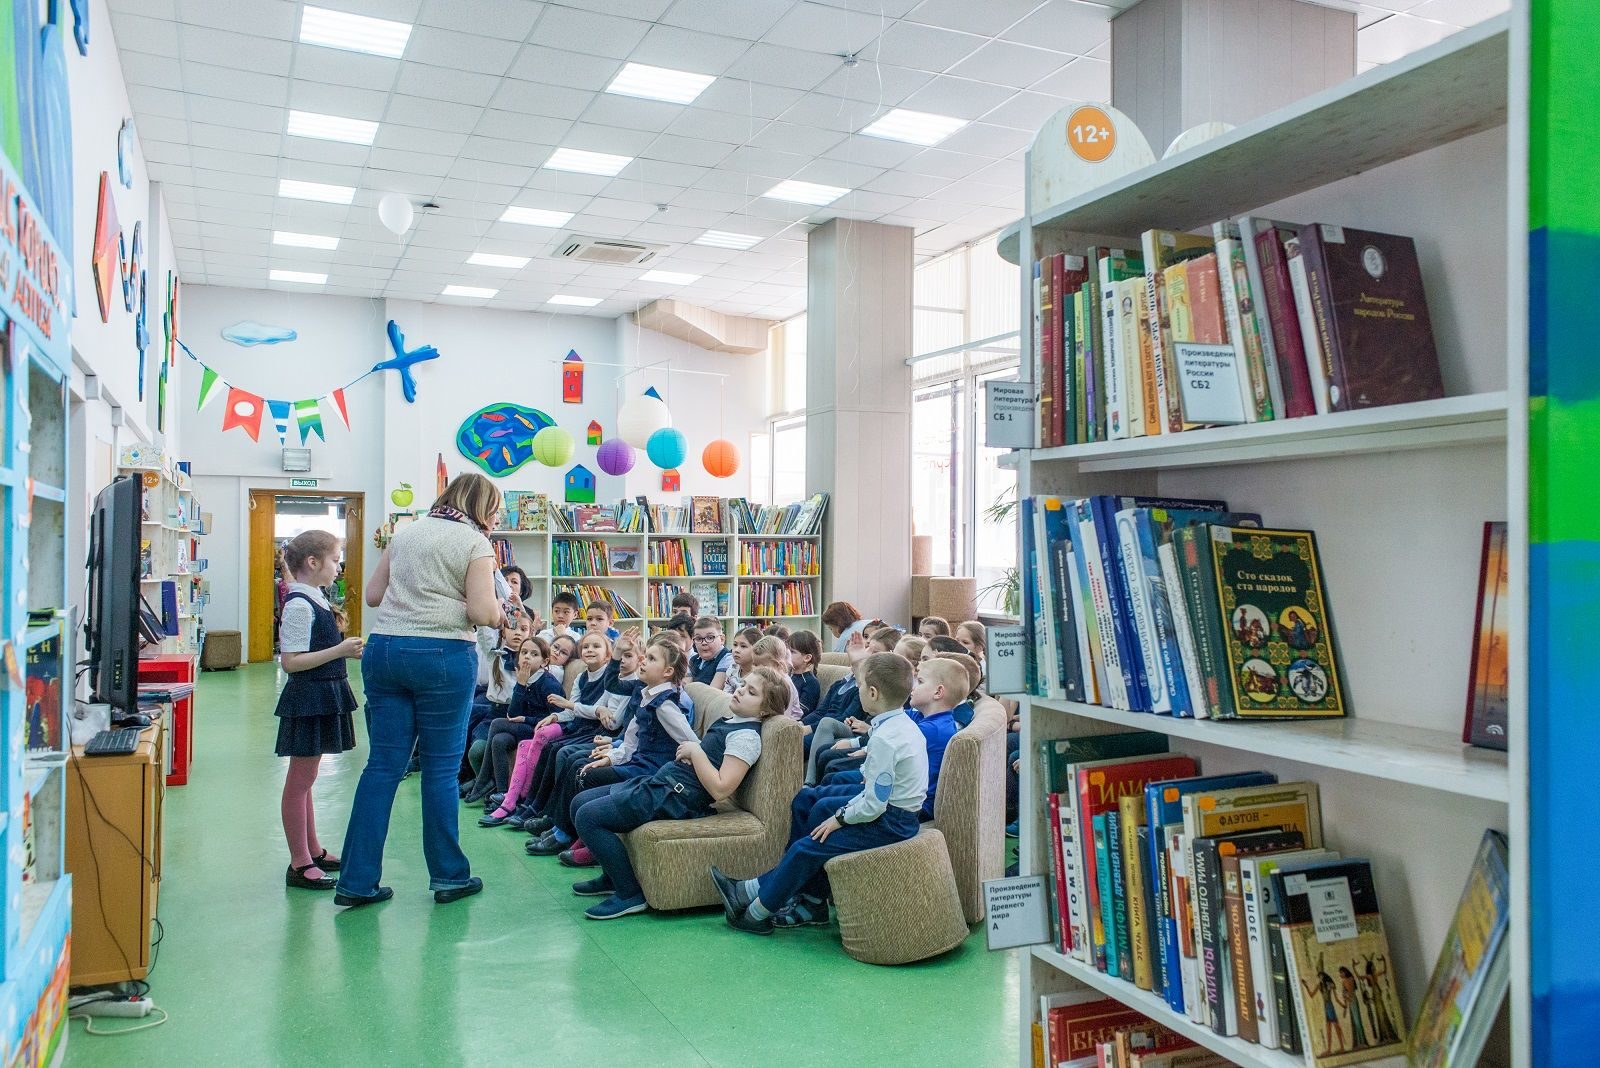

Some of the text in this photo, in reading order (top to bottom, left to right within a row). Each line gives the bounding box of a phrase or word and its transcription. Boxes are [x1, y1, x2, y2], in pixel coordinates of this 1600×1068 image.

[1073, 125, 1110, 143] 12+
[1185, 360, 1231, 368] литературы
[1190, 380, 1210, 389] СБ2
[993, 387, 1024, 395] Мировая
[703, 553, 727, 563] РОССИЯ
[1237, 570, 1293, 582] Сто сказок
[1256, 584, 1297, 593] народов
[1162, 649, 1171, 665] ПРО
[1219, 812, 1260, 826] ФАЭТОН
[1066, 848, 1078, 916] ГОМЕР
[1107, 811, 1127, 949] МИФЫ ДРЕВНЕЙ ГРЕЦИИ
[989, 882, 1040, 893] Произведения
[990, 892, 1032, 902] литературы
[991, 902, 1025, 912] Древнего
[991, 912, 1010, 920] мира
[993, 922, 999, 931] А
[1195, 851, 1217, 1003] МИФЫ ДРЕВНЕГО РИМА
[1247, 904, 1257, 941] ЭЗОП
[1230, 903, 1249, 1021] ДРЕВНИЙ ВОСТОК
